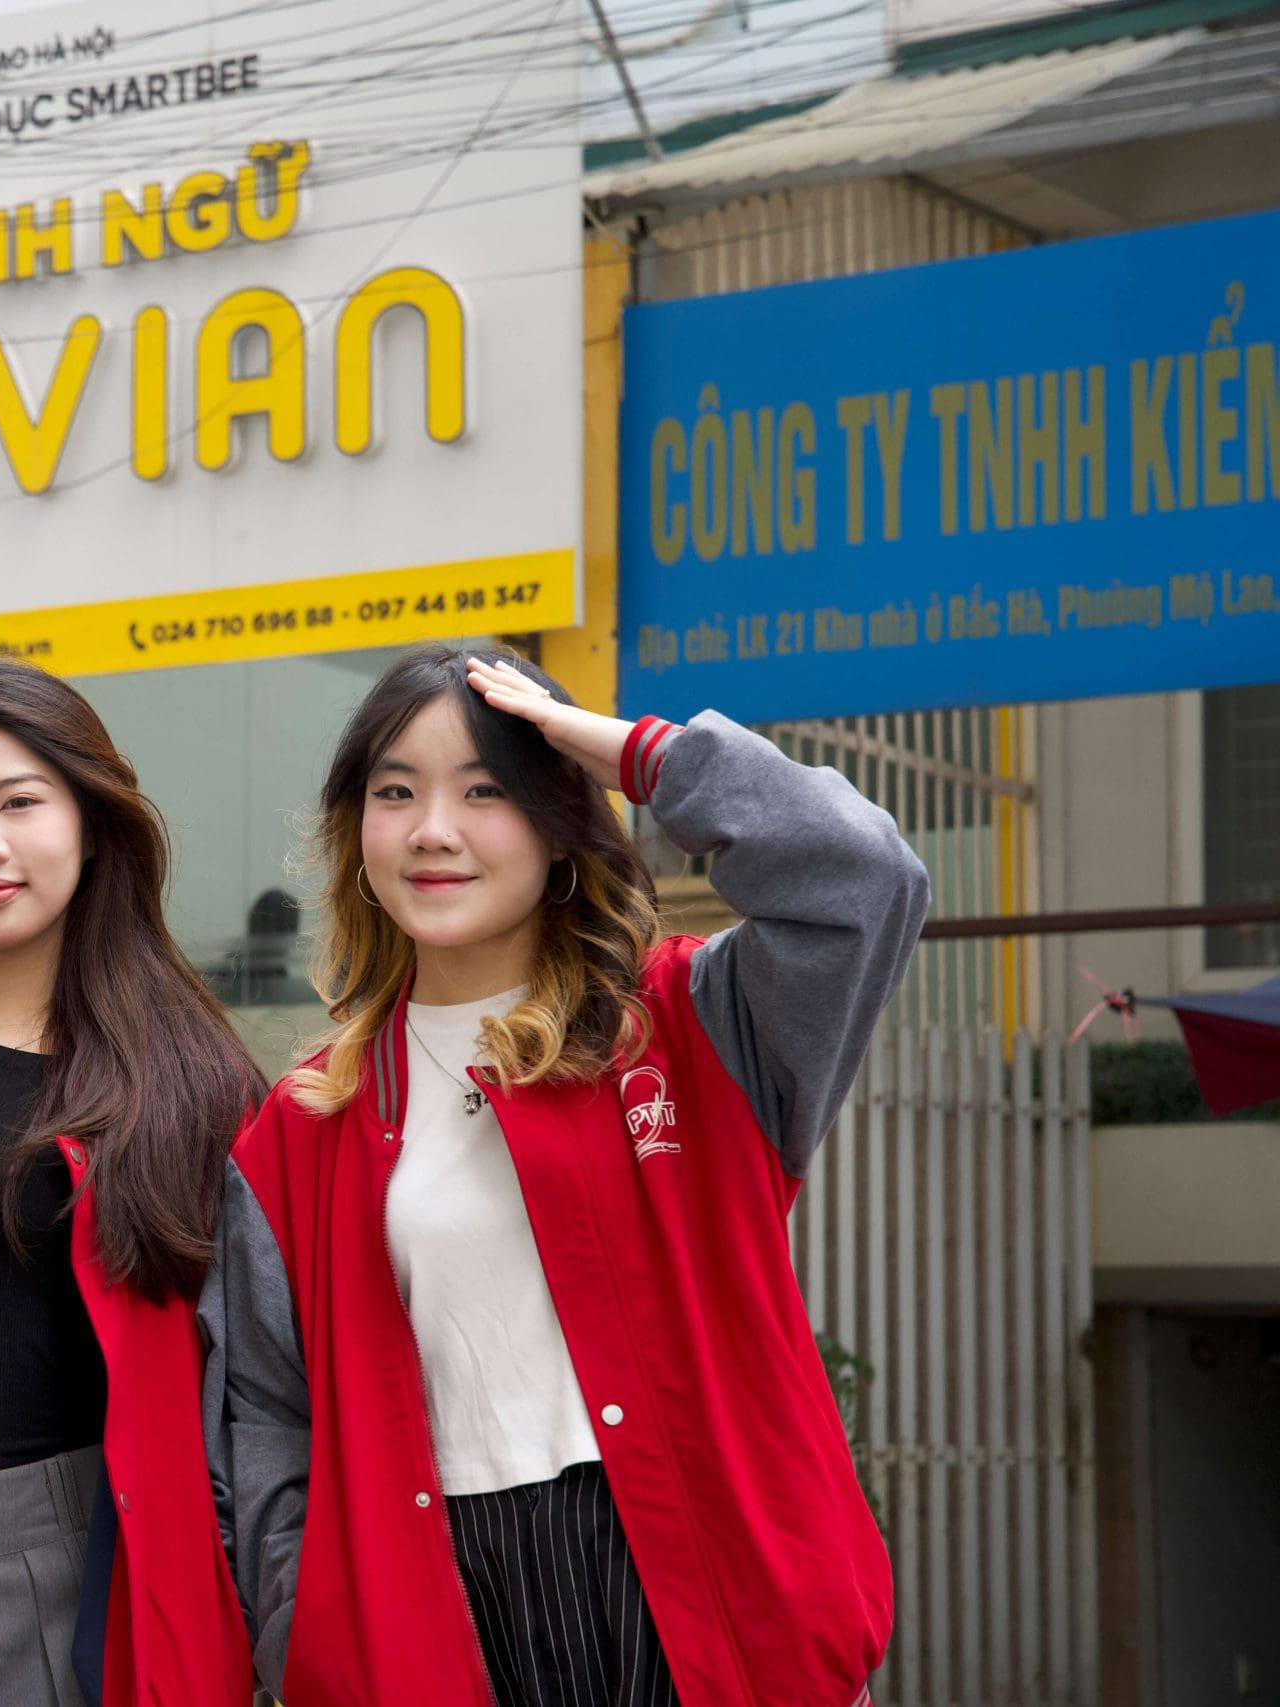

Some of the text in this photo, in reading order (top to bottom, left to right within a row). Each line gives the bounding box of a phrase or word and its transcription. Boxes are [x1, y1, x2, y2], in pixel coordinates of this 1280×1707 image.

[33, 32, 66, 63] HÀ
[72, 25, 116, 60] NỘI
[66, 54, 259, 124] SMARTBEE
[101, 137, 312, 268] NGỮ
[649, 383, 817, 567] CÔNG
[837, 388, 910, 546] TY
[930, 366, 1106, 536] TNHH
[151, 620, 197, 645] 024
[204, 615, 245, 638] 710
[253, 607, 297, 634] 696
[306, 603, 334, 627] 88
[358, 598, 405, 623] 097
[414, 593, 445, 616] 44
[455, 588, 485, 613] 98
[495, 582, 541, 609] 347
[737, 614, 769, 661] LK
[775, 609, 805, 656] 21
[813, 607, 863, 654] Khu
[869, 599, 917, 648] nhà
[1007, 587, 1052, 638] Hà,
[1170, 570, 1214, 627] Mộ
